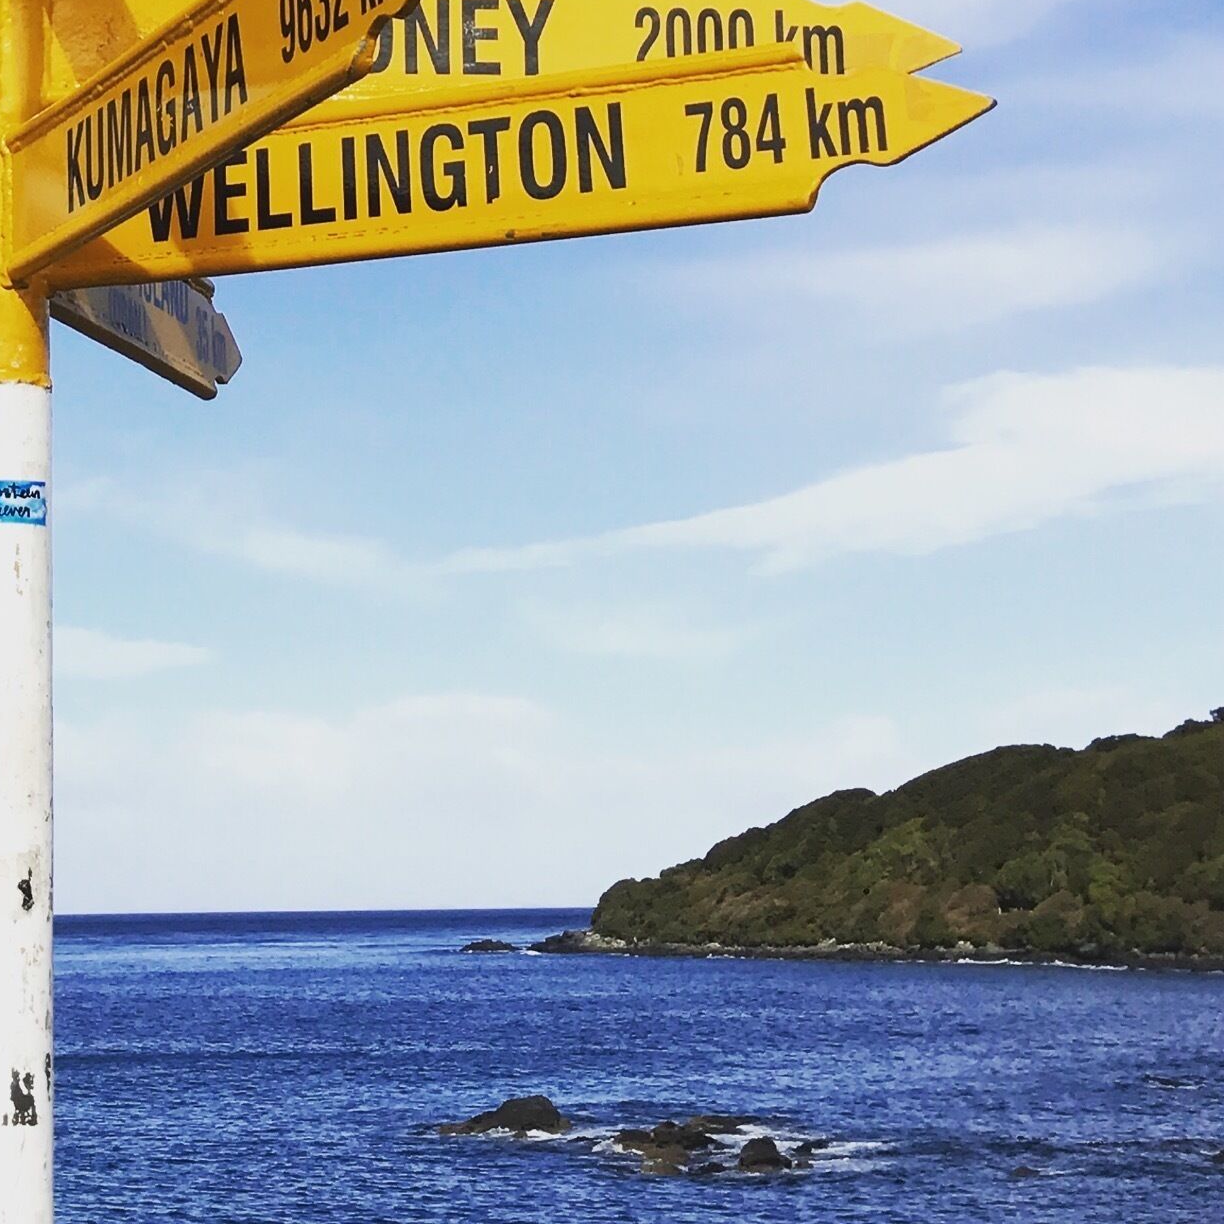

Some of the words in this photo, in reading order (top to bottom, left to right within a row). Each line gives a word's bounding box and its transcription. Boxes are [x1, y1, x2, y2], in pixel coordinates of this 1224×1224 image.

[66, 13, 248, 214] KUMAGAYA
[635, 7, 755, 62] 2000
[775, 9, 845, 75] km
[148, 101, 627, 243] WELLINGTON
[684, 93, 787, 173] 784
[806, 87, 888, 159] km
